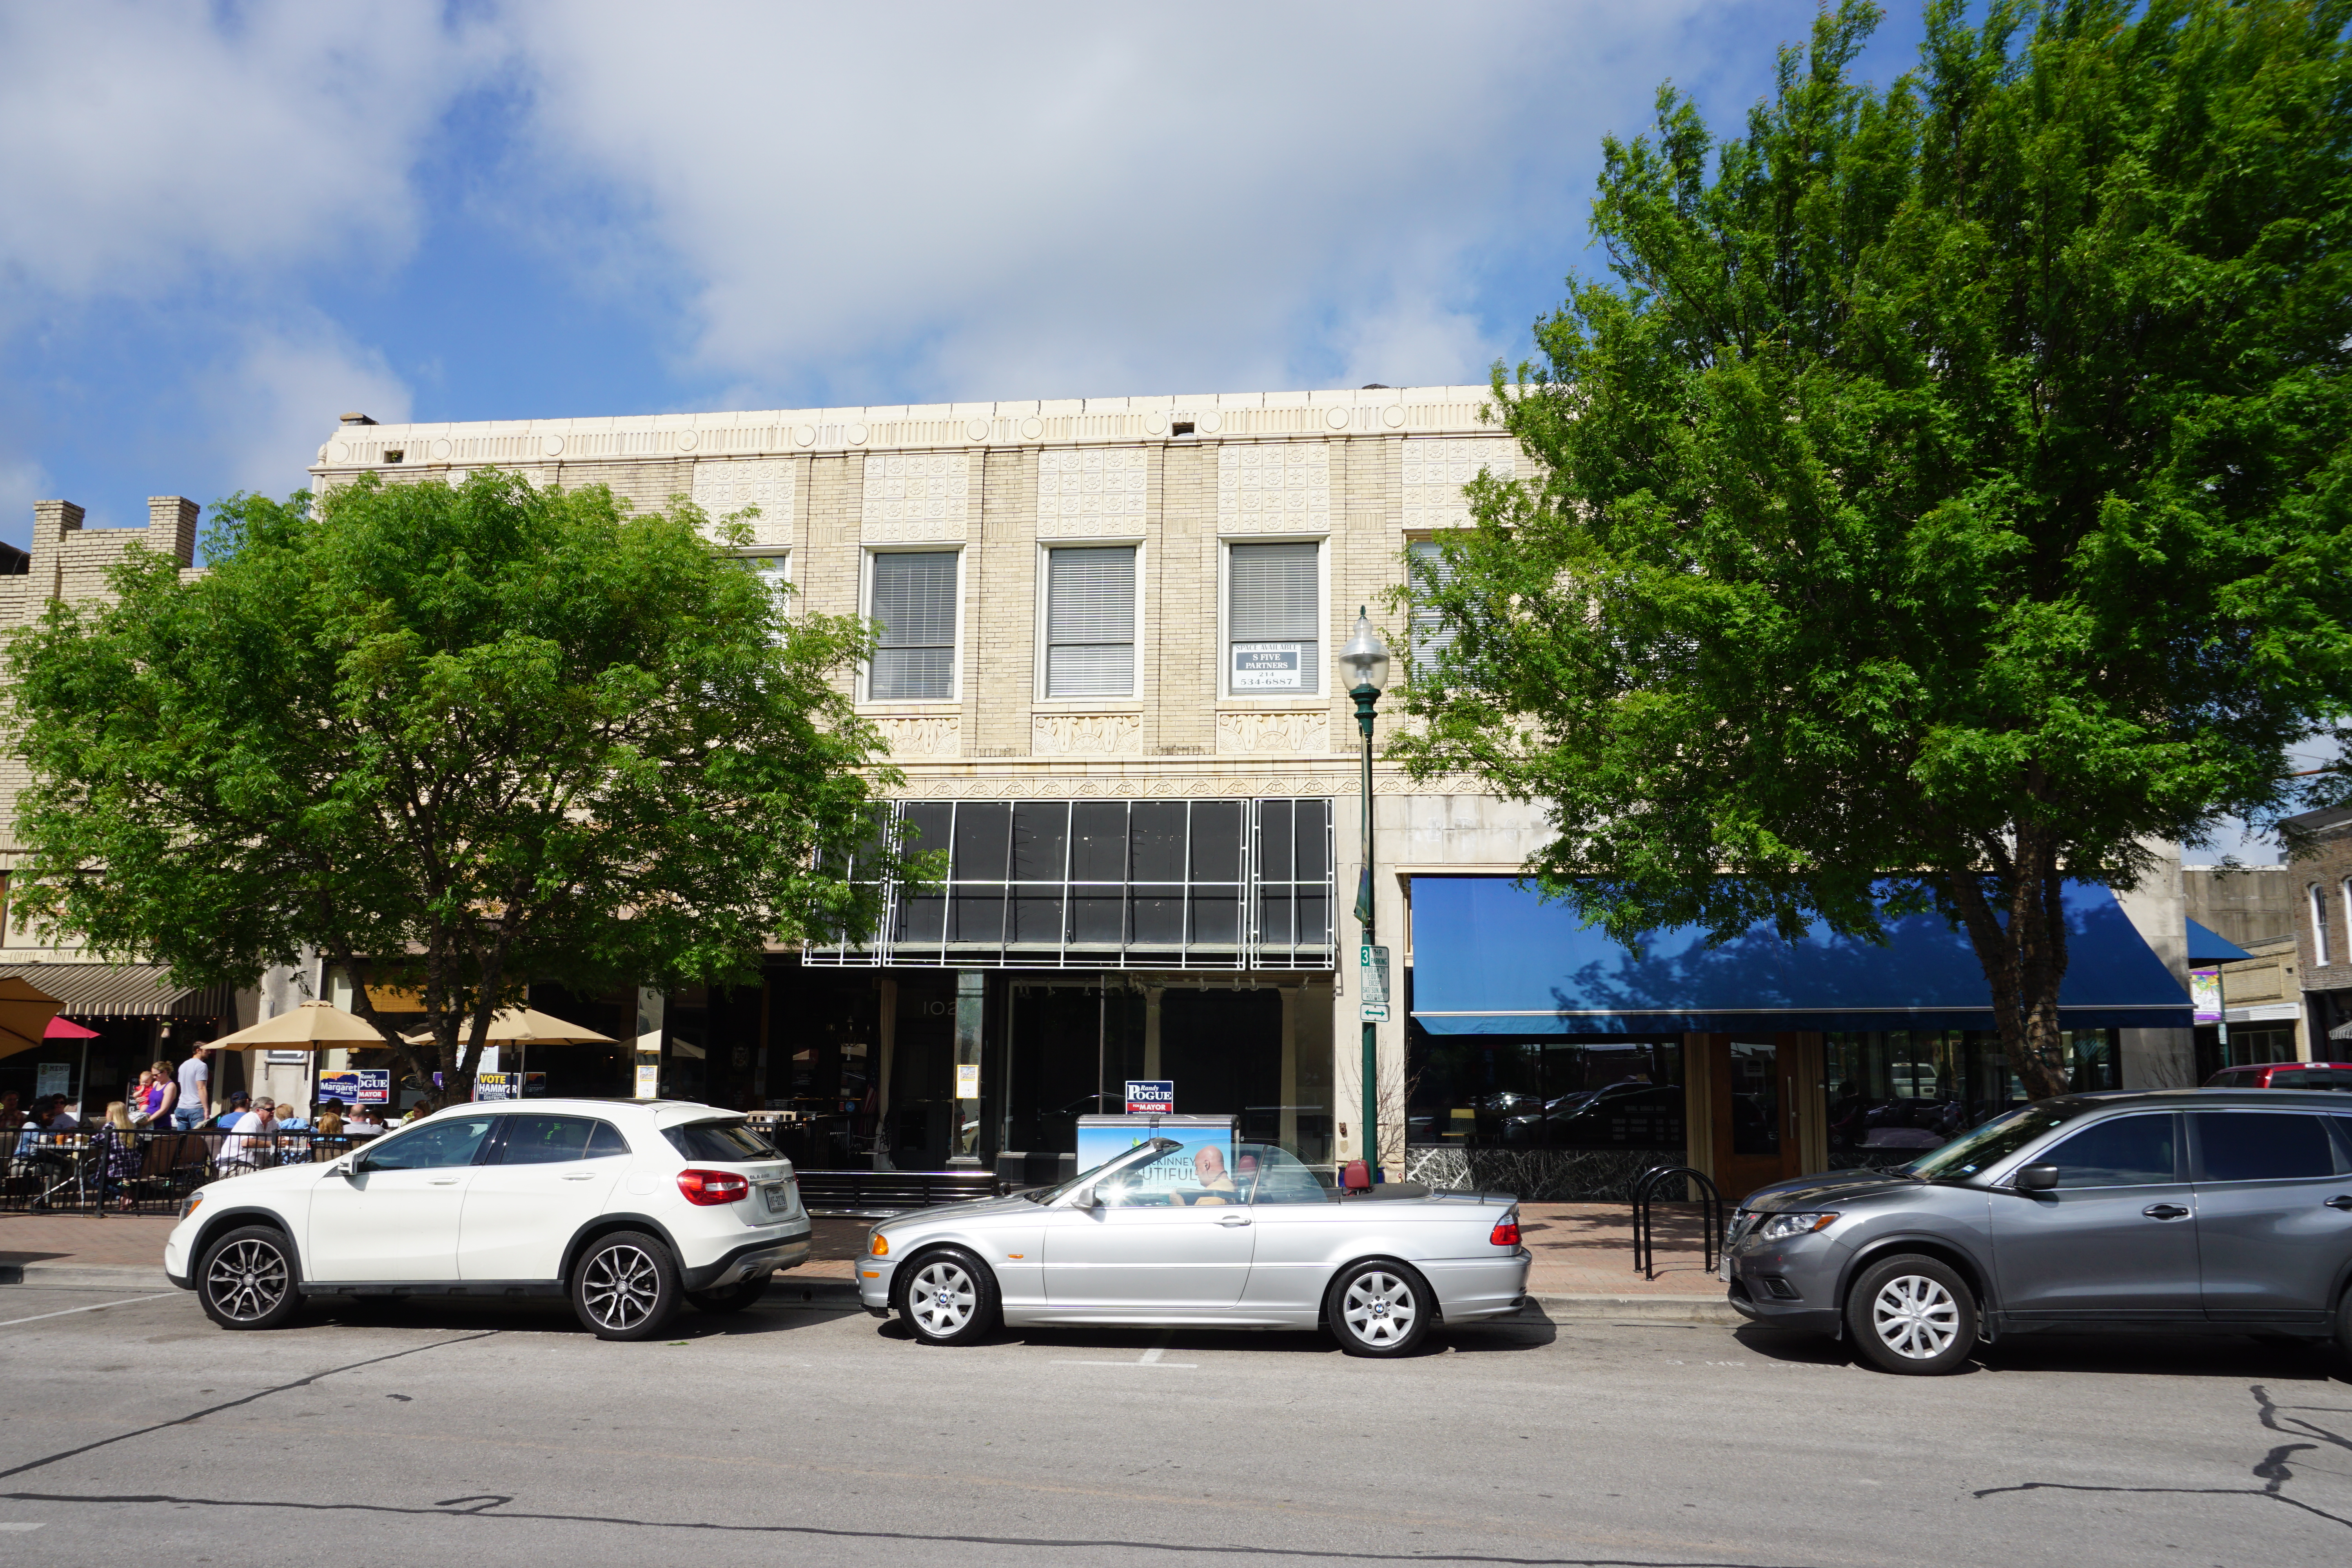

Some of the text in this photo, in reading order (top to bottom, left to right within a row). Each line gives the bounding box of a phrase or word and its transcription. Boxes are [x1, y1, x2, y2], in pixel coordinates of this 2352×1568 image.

[10, 951, 37, 962] COFFEE
[1362, 949, 1368, 964] 3
[480, 1074, 506, 1084] VOTE
[321, 1082, 358, 1093] Margaret
[479, 1083, 517, 1093] HAMMR
[1127, 1085, 1172, 1100] POGUE
